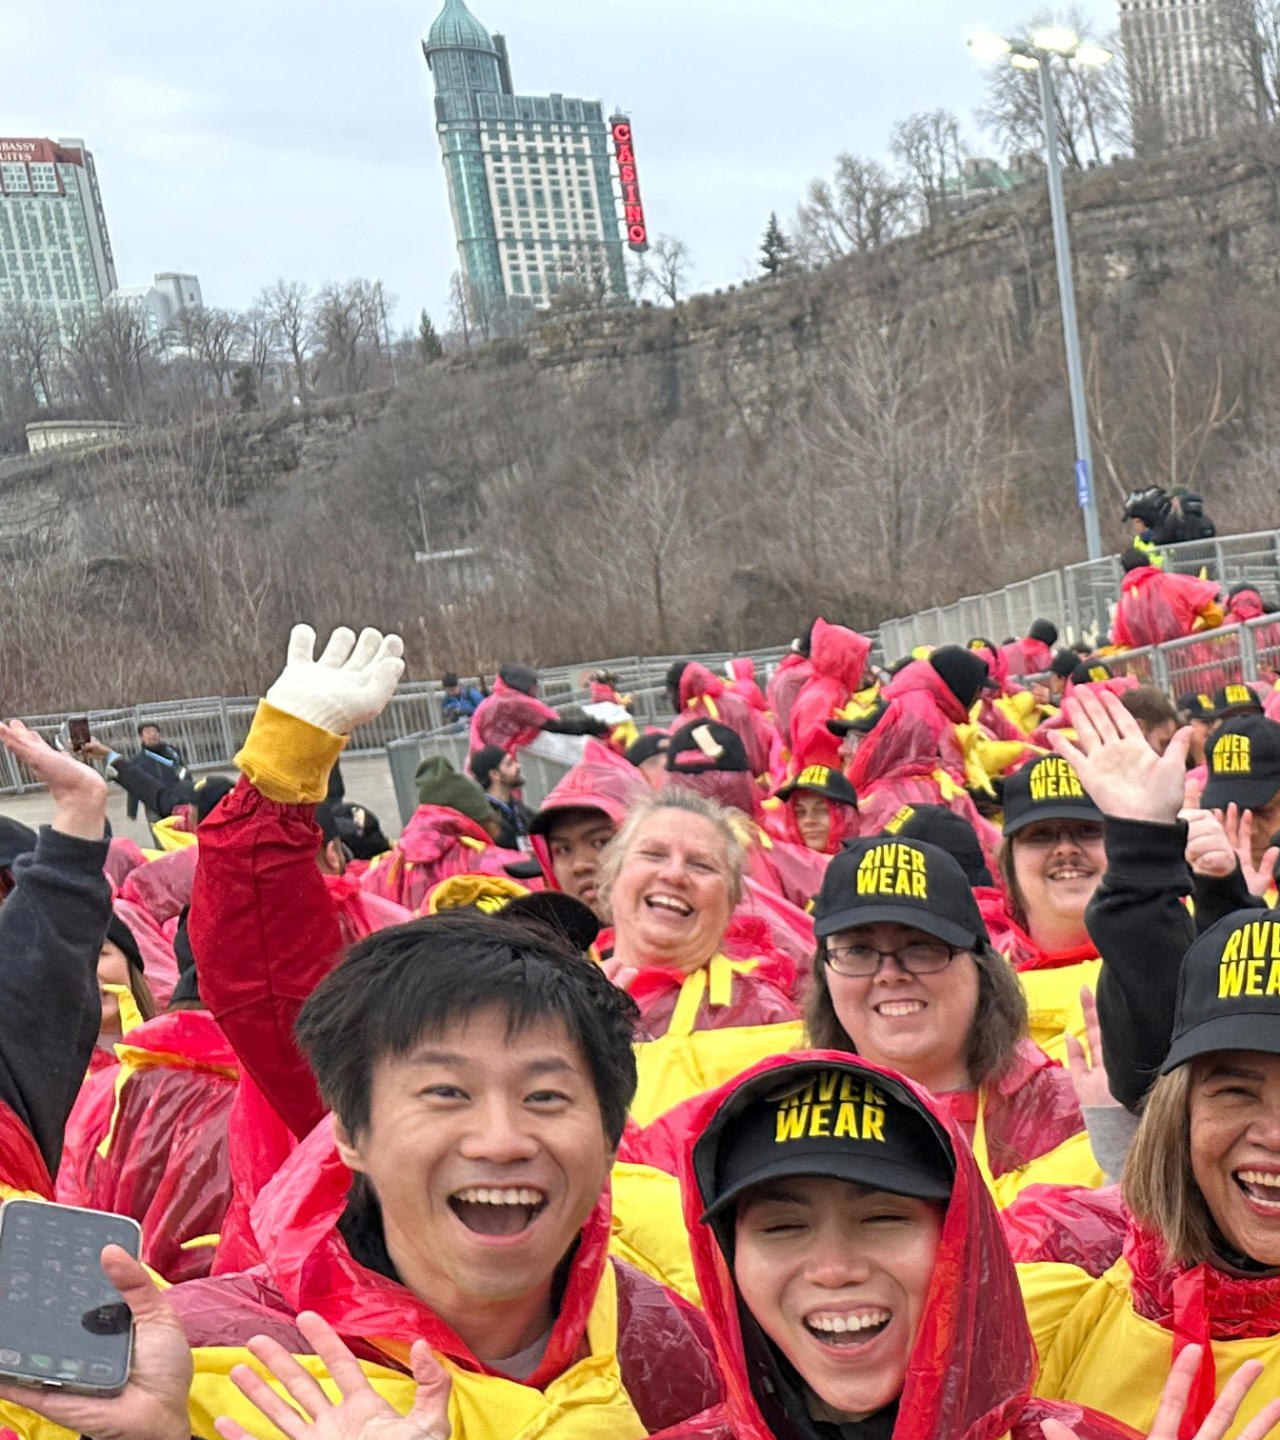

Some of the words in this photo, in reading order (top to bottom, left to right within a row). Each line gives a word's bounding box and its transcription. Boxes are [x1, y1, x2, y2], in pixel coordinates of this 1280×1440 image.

[0, 142, 37, 152] BASSY
[614, 124, 646, 244] CASINO
[1031, 777, 1083, 800] WEAR
[859, 843, 926, 872] RIVER
[857, 867, 927, 899] WEAR
[775, 1102, 886, 1142] WEAR
